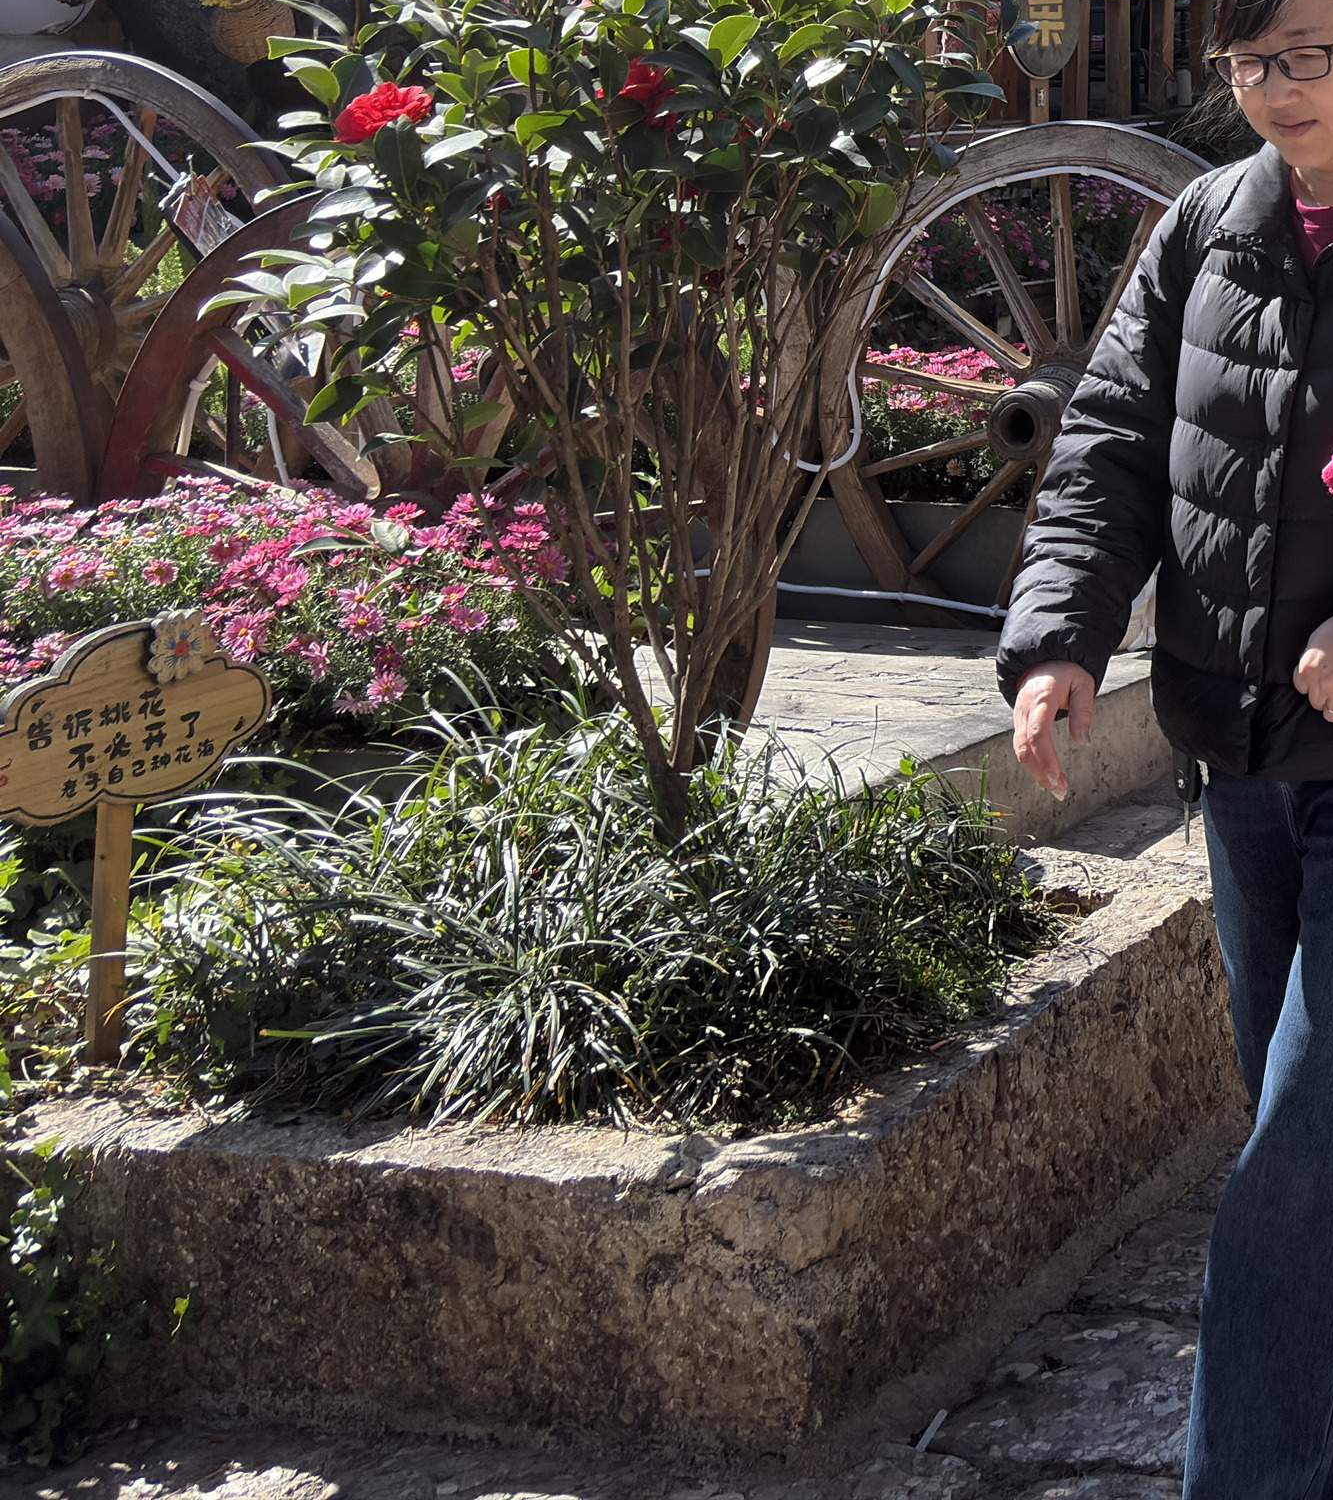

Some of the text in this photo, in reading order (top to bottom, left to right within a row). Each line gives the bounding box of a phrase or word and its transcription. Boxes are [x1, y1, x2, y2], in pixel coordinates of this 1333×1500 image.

[27, 687, 166, 751] 告诉桃花
[68, 711, 200, 772] 不必开了
[61, 739, 215, 798] 老子自己种花海
